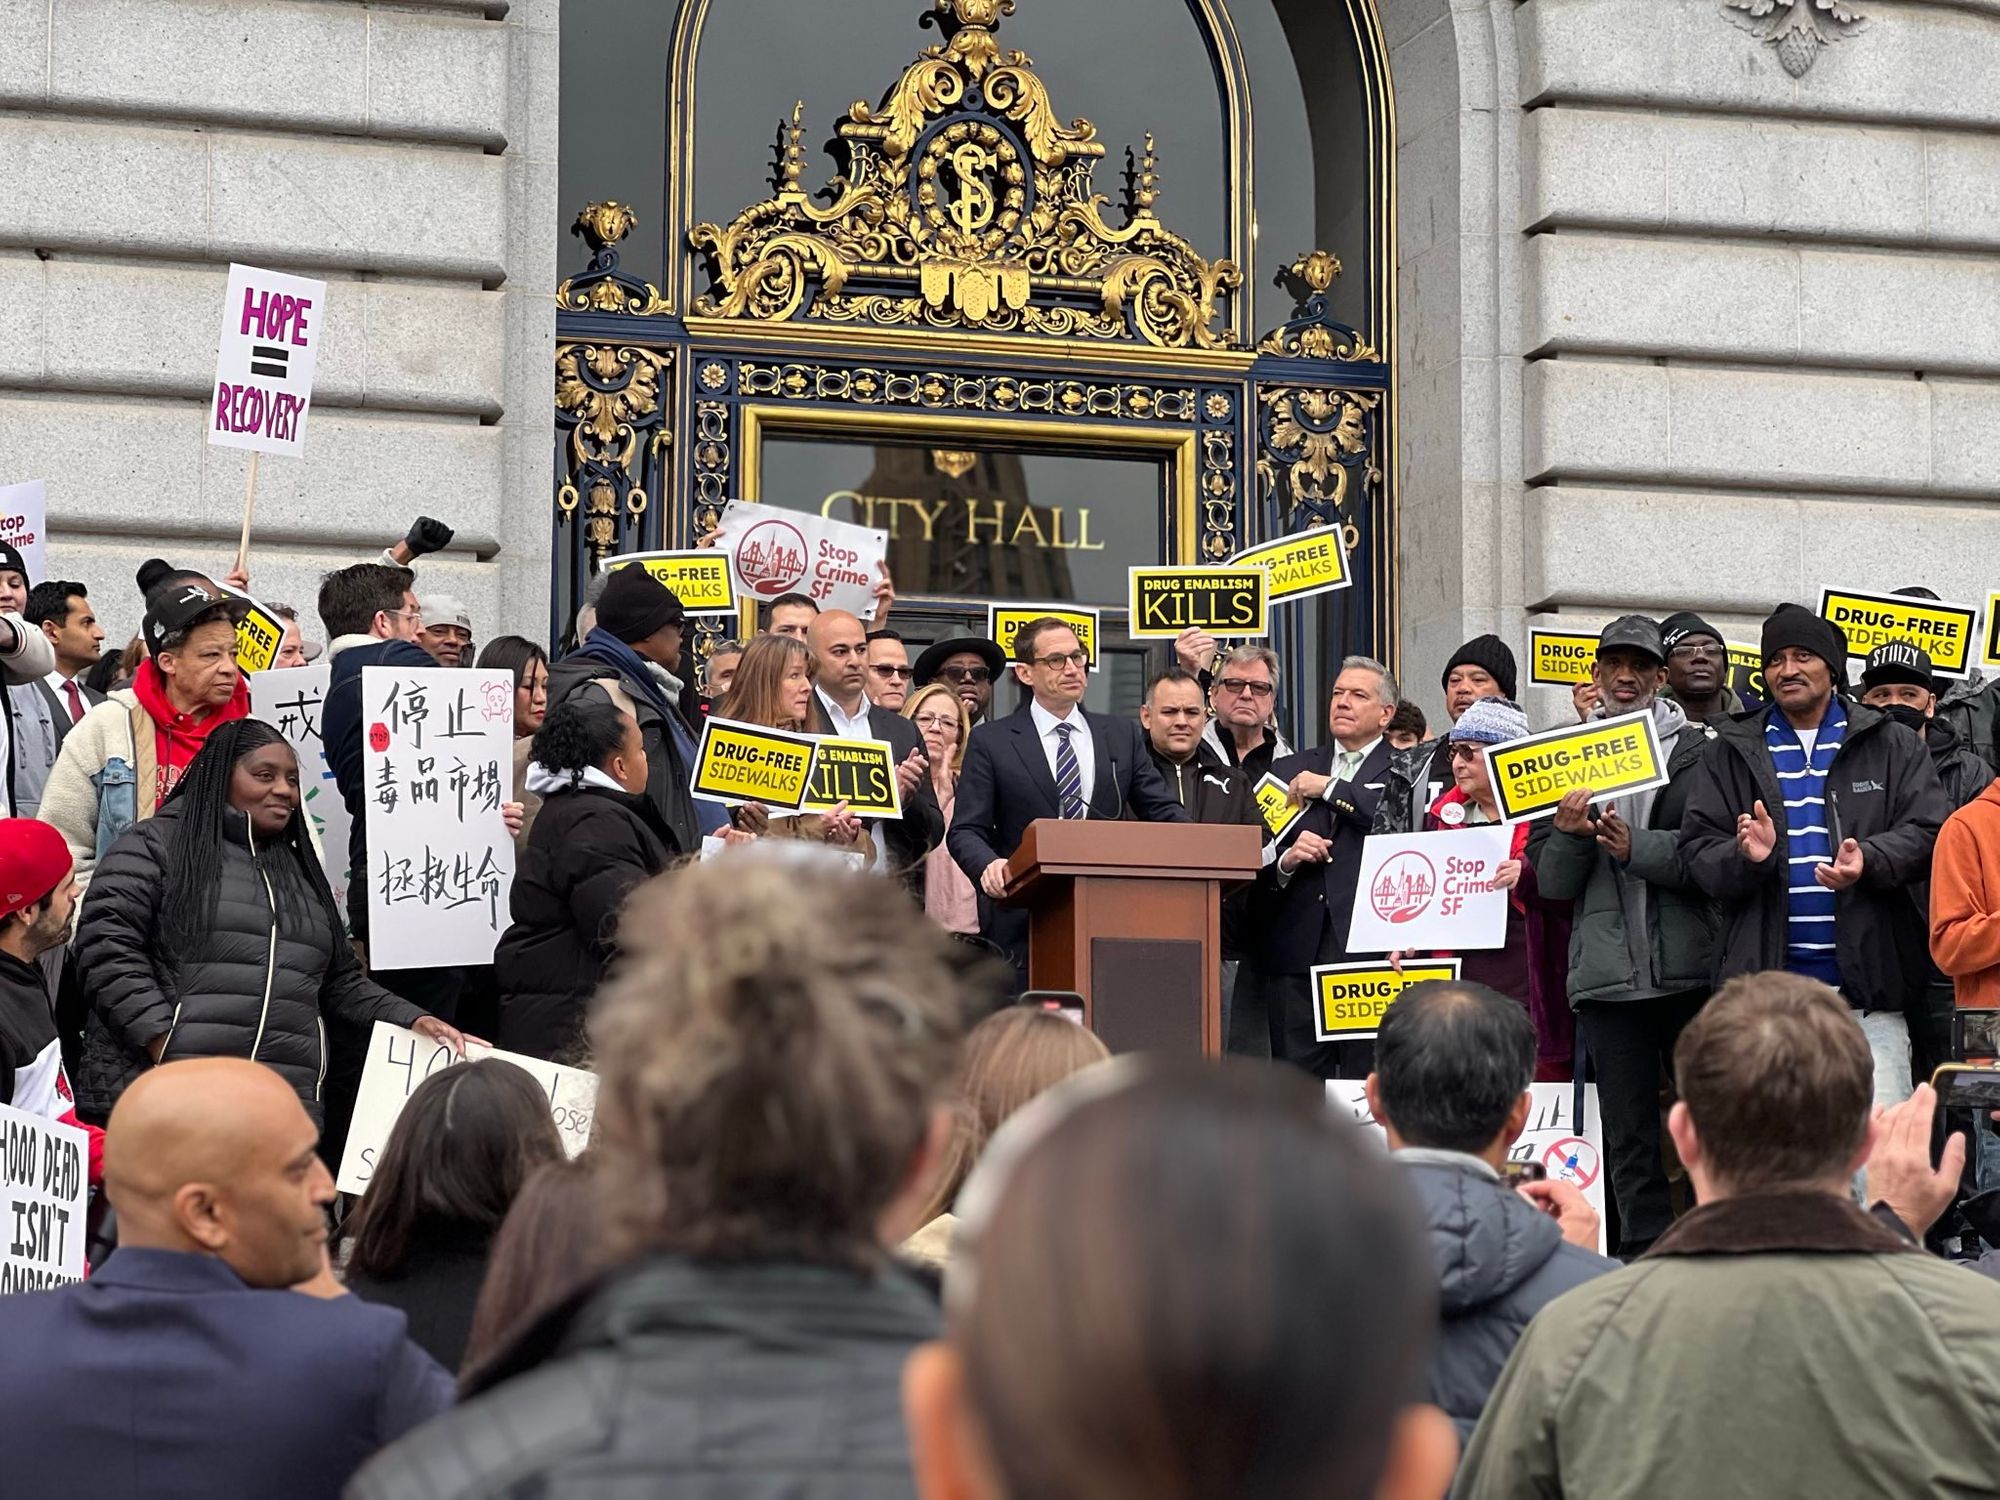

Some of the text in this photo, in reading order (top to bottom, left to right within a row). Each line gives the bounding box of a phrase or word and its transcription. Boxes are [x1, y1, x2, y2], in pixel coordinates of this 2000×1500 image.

[240, 287, 312, 346] HOPE
[215, 382, 306, 442] RECOVERY
[0, 515, 25, 532] top
[821, 490, 1104, 549] CITY HALL
[818, 538, 858, 567] Stop
[1253, 544, 1329, 570] G-FREE
[651, 567, 721, 581] G-FREE
[815, 560, 869, 586] Crime
[1144, 579, 1253, 590] DRUG ENABLISM
[1269, 560, 1332, 586] WALKS
[809, 580, 834, 600] SF
[1144, 592, 1253, 625] KILLS
[1835, 607, 1959, 638] DRUG-FREE
[1541, 644, 1600, 659] DRUG-
[1841, 626, 1956, 657] IDEWALKS
[1542, 659, 1592, 675] SIDEW
[381, 680, 487, 749] 停止
[713, 741, 803, 772] DRUG-FREE
[830, 750, 883, 765] ENABLISM
[1507, 735, 1638, 779] DRUG-FREE
[709, 761, 798, 792] SIDEWALKS
[1514, 754, 1643, 799] SIDEWALKS
[1445, 856, 1485, 877] Stop
[378, 844, 506, 931] 拯救生命
[1443, 876, 1494, 895] Crime
[1440, 897, 1464, 915] SF
[43, 1132, 80, 1202] DEAD
[11, 1201, 69, 1267] ISN'T
